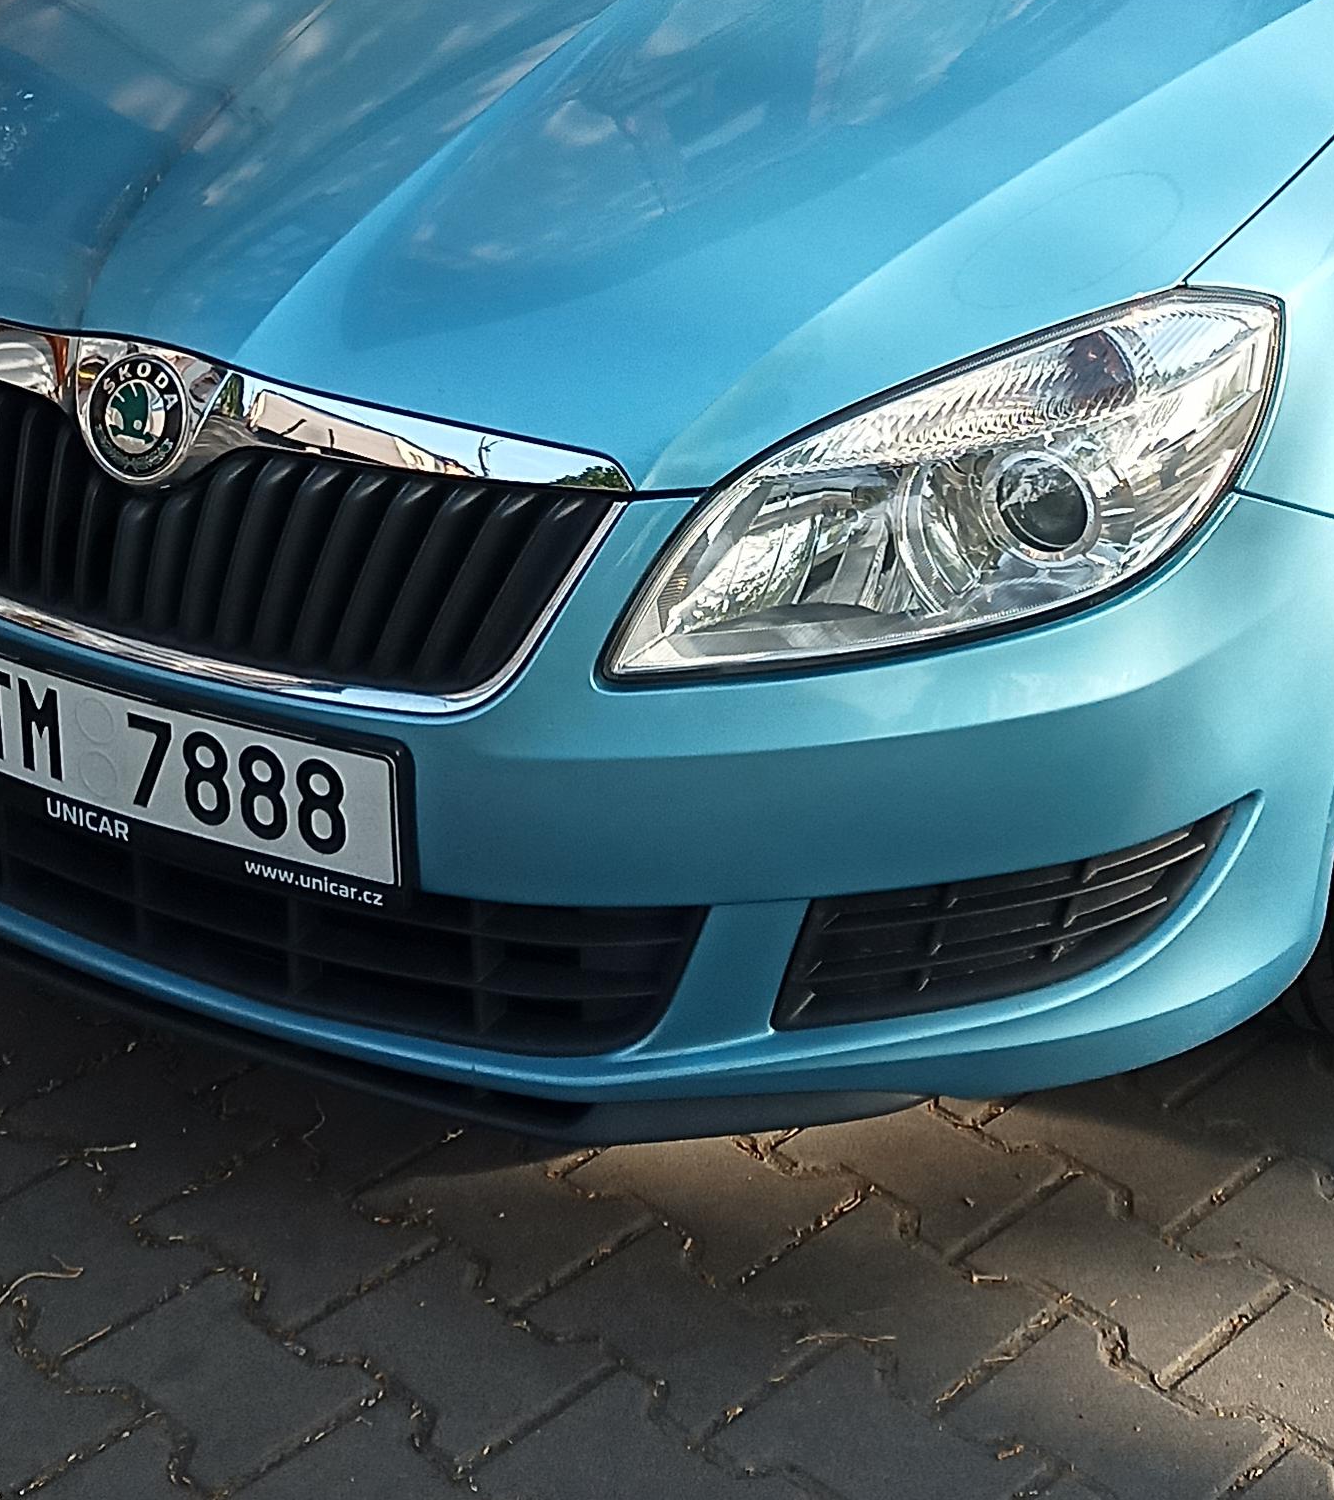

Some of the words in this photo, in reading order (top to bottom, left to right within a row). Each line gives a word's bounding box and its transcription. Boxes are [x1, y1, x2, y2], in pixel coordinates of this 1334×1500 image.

[126, 711, 347, 855] 7888
[46, 797, 130, 842] UNICAR
[244, 859, 384, 907] www.unicar.cz
